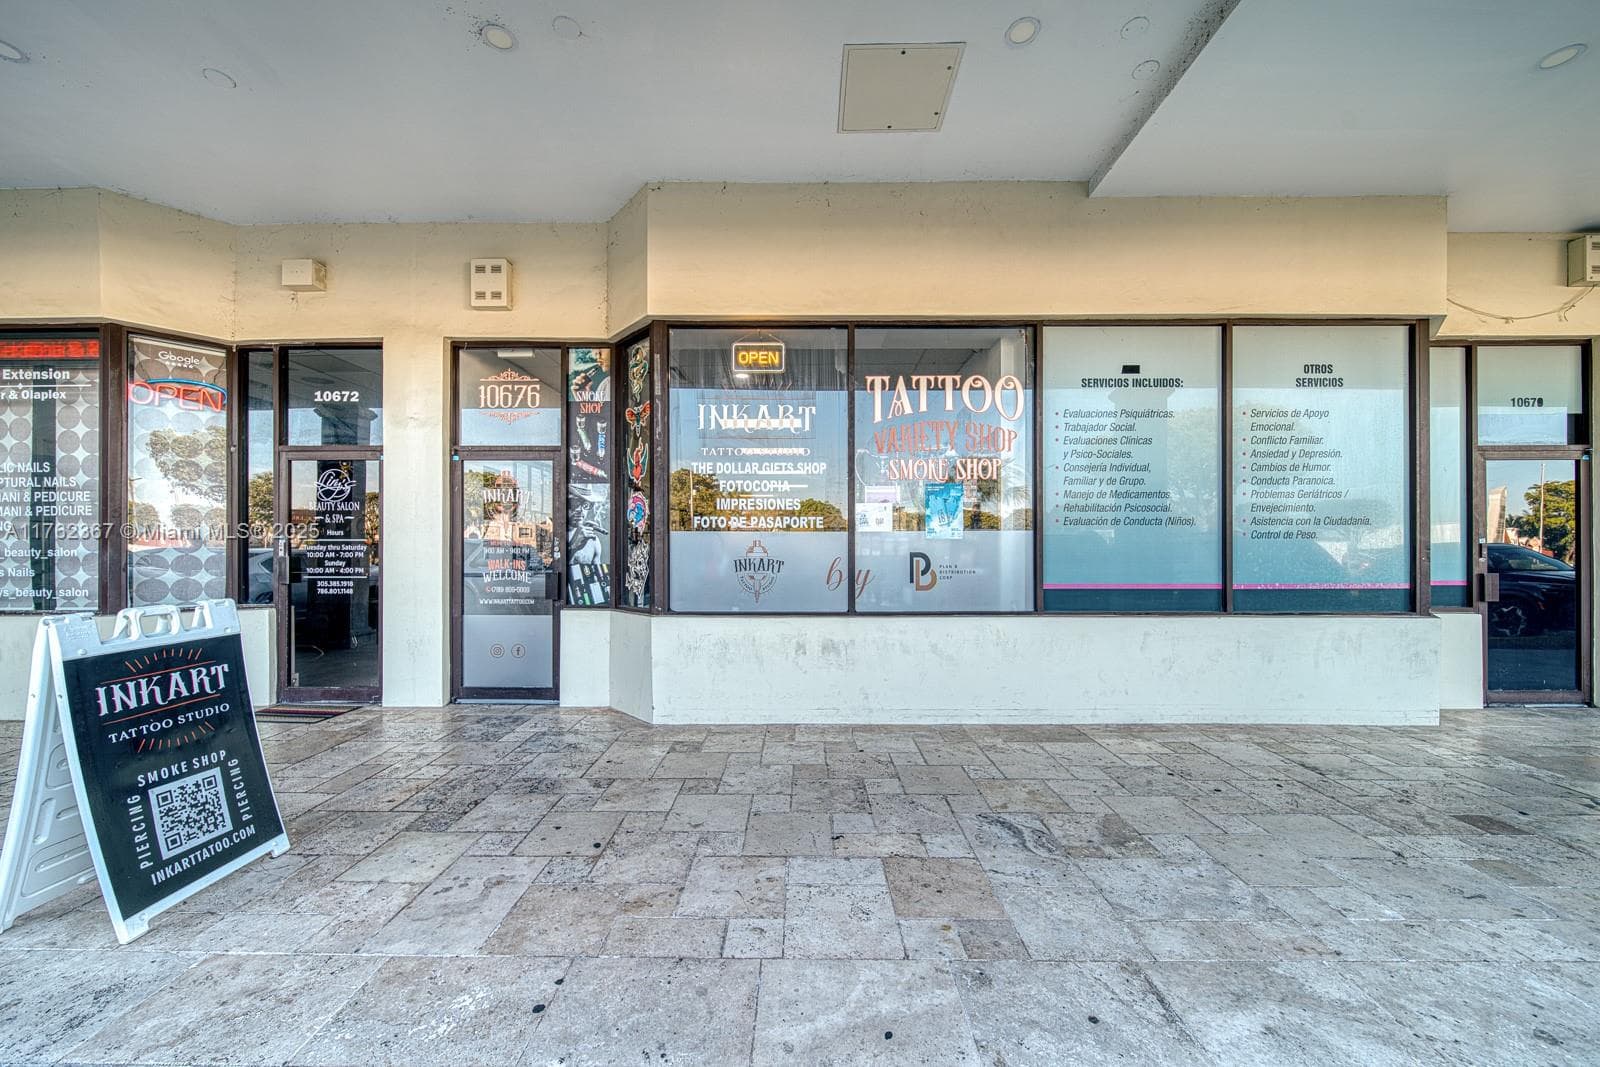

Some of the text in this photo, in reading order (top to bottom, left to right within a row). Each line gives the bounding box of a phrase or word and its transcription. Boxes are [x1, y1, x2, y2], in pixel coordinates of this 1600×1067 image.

[738, 351, 780, 366] OPEN
[2, 368, 70, 380] Extension
[1303, 364, 1334, 374] OTROS
[1081, 378, 1184, 388] SERVICIOS INCLUIDOS:
[1295, 377, 1344, 388] SERVICIOS
[8, 390, 18, 400] &
[21, 389, 66, 401] Olaplex
[127, 381, 223, 413] OPEN
[314, 390, 360, 402] 10672
[478, 384, 541, 408] 10676
[576, 391, 606, 402] SMOKE
[864, 374, 1025, 424] TATTOO
[580, 402, 604, 414] SHOP
[1063, 408, 1118, 418] Evaluaciones
[698, 403, 817, 434] INKART
[1250, 408, 1330, 420] Servicios de Apoyo
[1064, 422, 1137, 433] Trabajador Social.
[1250, 421, 1296, 431] Emocional.
[873, 419, 1018, 455] VARIETY SHOP
[1063, 435, 1153, 445] Evaluaciones Clínicas
[1250, 435, 1325, 445] Conflicto Familiar.
[1062, 449, 1134, 460] y Psico-Sociales.
[1250, 448, 1343, 460] Ansiedad y Depresión.
[17, 462, 51, 473] NAILS
[691, 462, 827, 475] THE DOLLAR GIFTS SHOP
[888, 458, 1002, 482] SMOKE SHOP
[1063, 462, 1108, 474] Consejería
[1250, 462, 1332, 472] Cambios de Humor.
[43, 477, 77, 487] NAILS
[719, 479, 791, 492] FOTOCOPIA
[1063, 476, 1098, 486] Familiar
[1106, 476, 1117, 486] de
[1118, 476, 1147, 488] Grupo.
[1250, 476, 1336, 486] Conducta Paranoica.
[23, 491, 31, 502] &
[34, 491, 91, 502] PEDICURE
[1063, 489, 1095, 500] Manejo
[1096, 489, 1107, 499] de
[1250, 489, 1296, 499] Problemas
[1297, 488, 1342, 499] Geriátricos
[308, 501, 360, 511] BEAUTY SALON
[716, 497, 801, 511] IMPRESIONES
[1063, 503, 1173, 512] Rehabilitación Psicosocial.
[1250, 502, 1317, 514] Envejecimiento.
[25, 505, 33, 516] &
[36, 505, 93, 516] PEDICURE
[324, 514, 345, 523] & SPA
[693, 516, 824, 529] FOTO DE PASAPORTE
[1063, 516, 1108, 526] Evaluación
[1110, 516, 1121, 526] de
[1123, 516, 1163, 526] Conducta
[1250, 515, 1372, 526] Asistencia con la Ciudadanía.
[1250, 529, 1319, 539] Control de Peso.
[328, 544, 340, 552] thru
[341, 544, 367, 552] Saturday
[325, 560, 346, 568] Sunday
[487, 560, 527, 571] WALK-INS
[733, 558, 785, 574] INKART
[7, 567, 35, 577] Nails
[482, 569, 532, 584] WELCOME
[95, 663, 230, 717] INKART
[108, 703, 230, 744] TATTOO STUDIO
[137, 750, 227, 787] SMOKE SHOP
[227, 758, 253, 822] PIERCING
[127, 794, 154, 870] PIERCING
[151, 824, 256, 886] INKARTTATOO.COM
